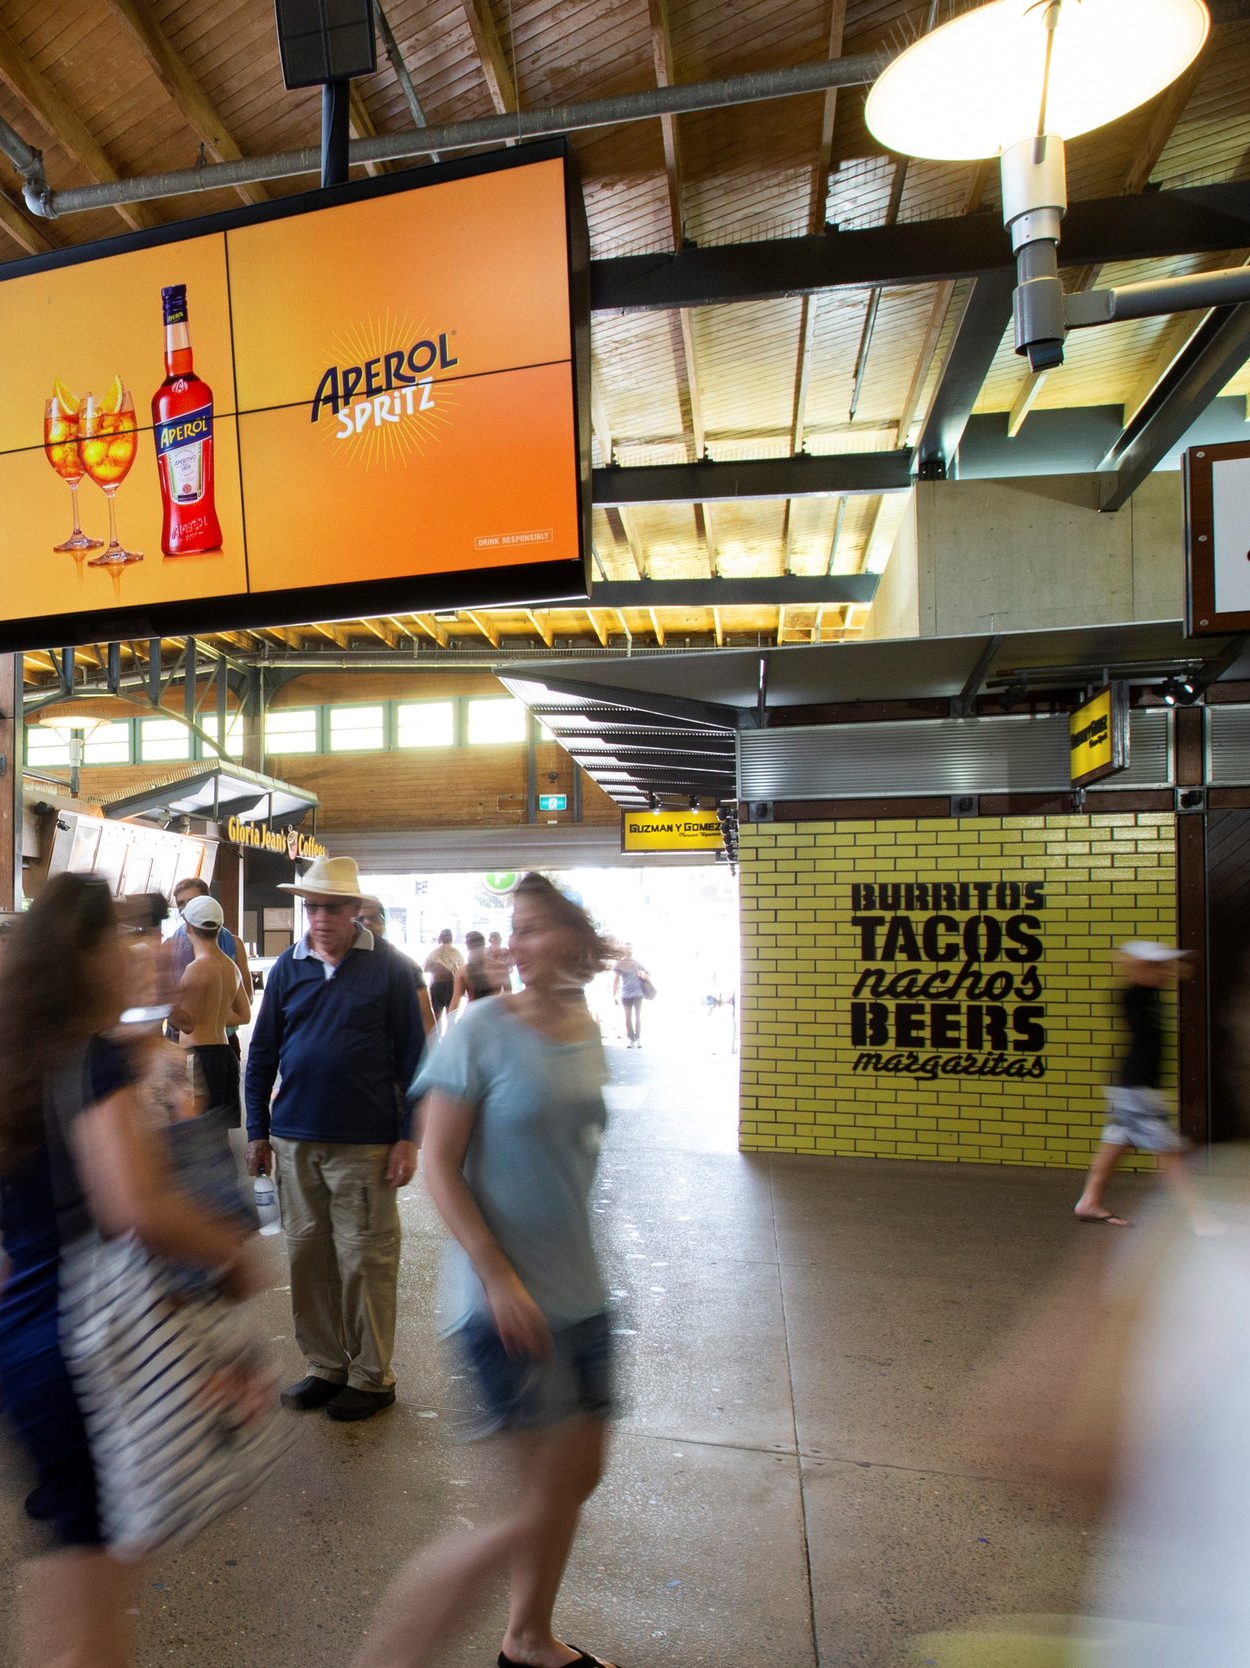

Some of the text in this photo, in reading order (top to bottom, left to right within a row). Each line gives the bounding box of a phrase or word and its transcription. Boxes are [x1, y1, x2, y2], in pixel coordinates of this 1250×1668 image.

[310, 332, 459, 424] APEROL
[335, 376, 435, 439] SPRITZ
[160, 416, 209, 449] APEROL
[477, 531, 550, 547] DRINK RESPONSIBLY
[228, 815, 261, 848] Gloria
[261, 823, 287, 854] Jean's
[629, 822, 721, 834] GUZMAN Y GOMEZ
[851, 881, 1045, 911] BURRITOS
[850, 914, 1043, 963] TACOS
[851, 957, 1043, 1001] nachos
[850, 1001, 1045, 1052] BEERS
[852, 1051, 1045, 1080] margaritas
